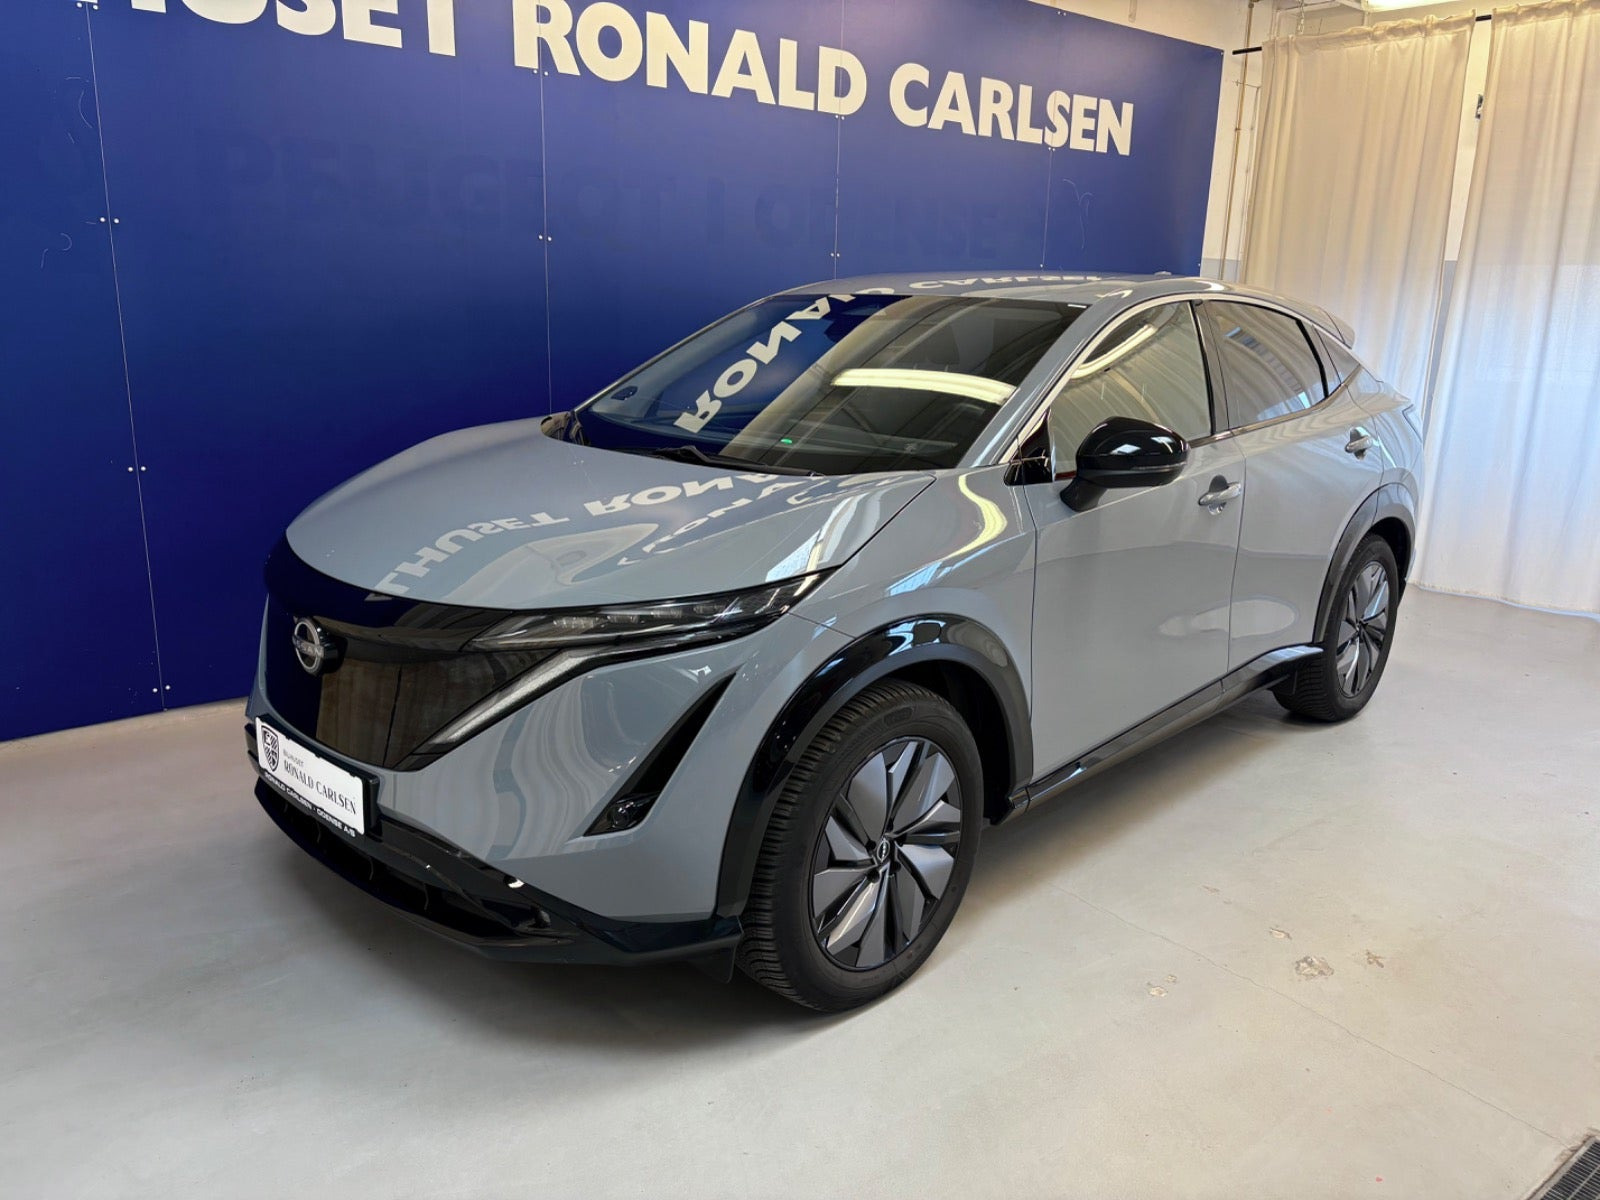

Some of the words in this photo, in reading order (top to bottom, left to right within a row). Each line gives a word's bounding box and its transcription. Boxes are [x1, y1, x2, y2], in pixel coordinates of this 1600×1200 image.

[512, 0, 867, 116] RONALD
[889, 62, 1134, 156] CARLSEN
[316, 780, 357, 815] CARLSEN
